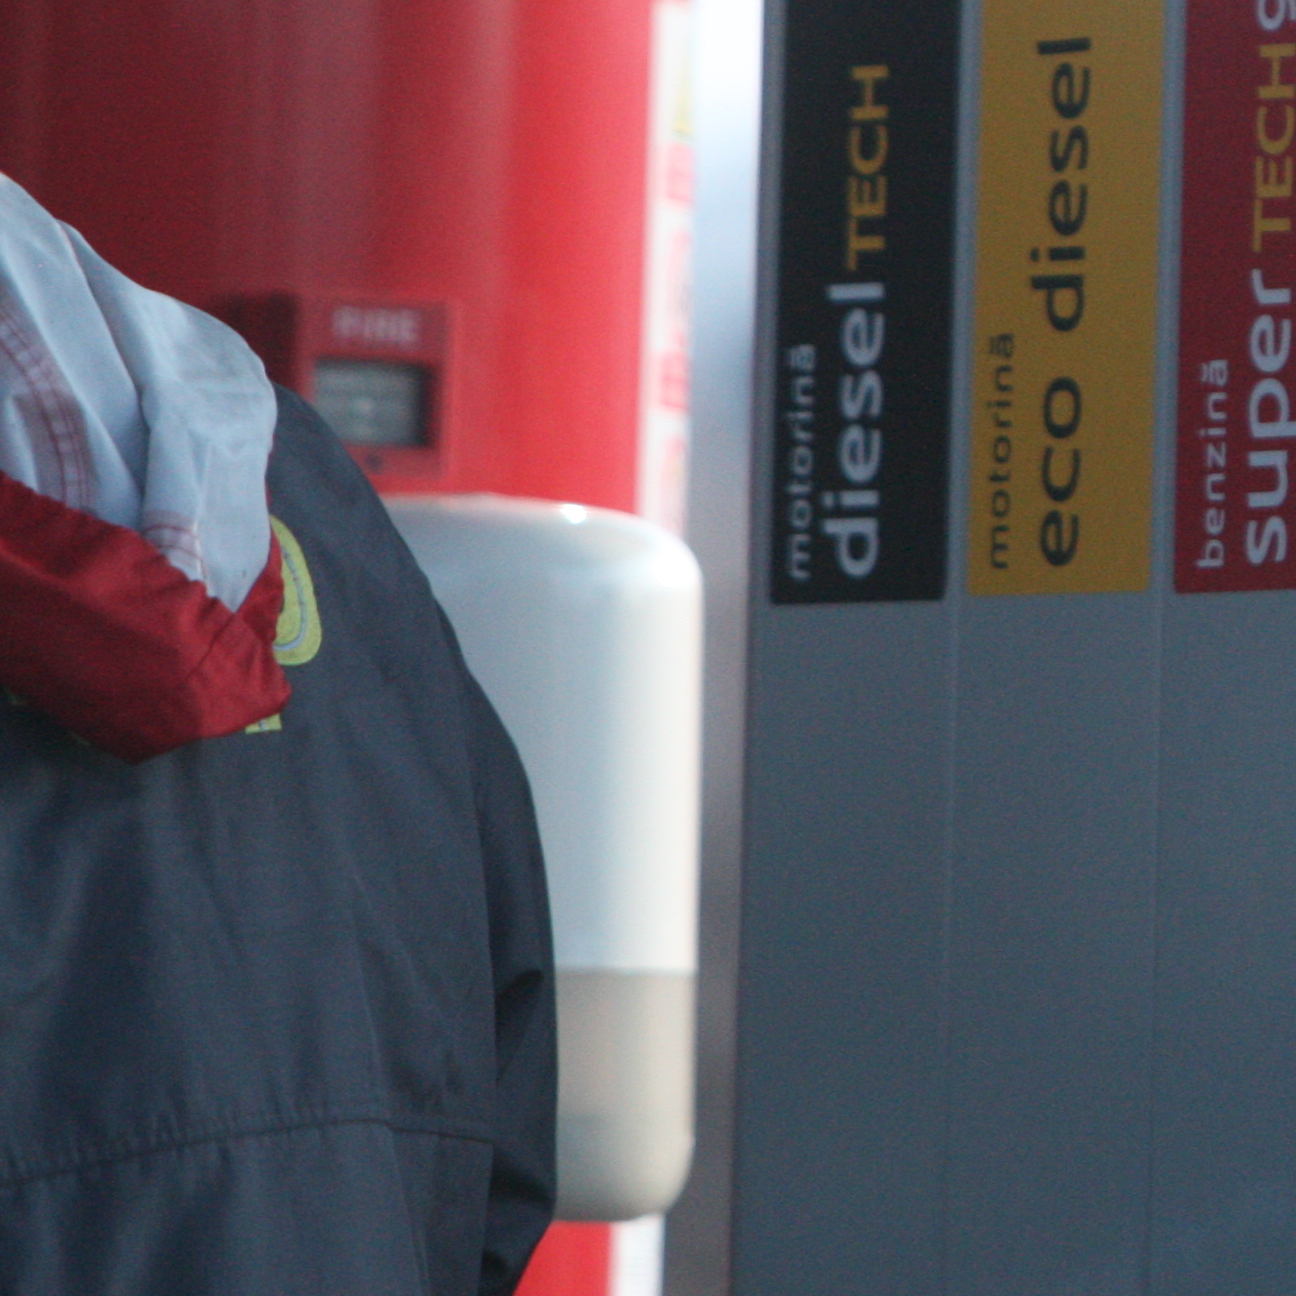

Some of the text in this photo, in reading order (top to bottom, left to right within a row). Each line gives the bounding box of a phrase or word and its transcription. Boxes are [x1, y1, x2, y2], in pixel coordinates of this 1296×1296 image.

[820, 63, 891, 578] diesel TECH
[1029, 37, 1092, 569] eco diesel
[785, 342, 817, 583] motorină
[986, 332, 1016, 571] motorină
[1196, 358, 1229, 570] benzină
